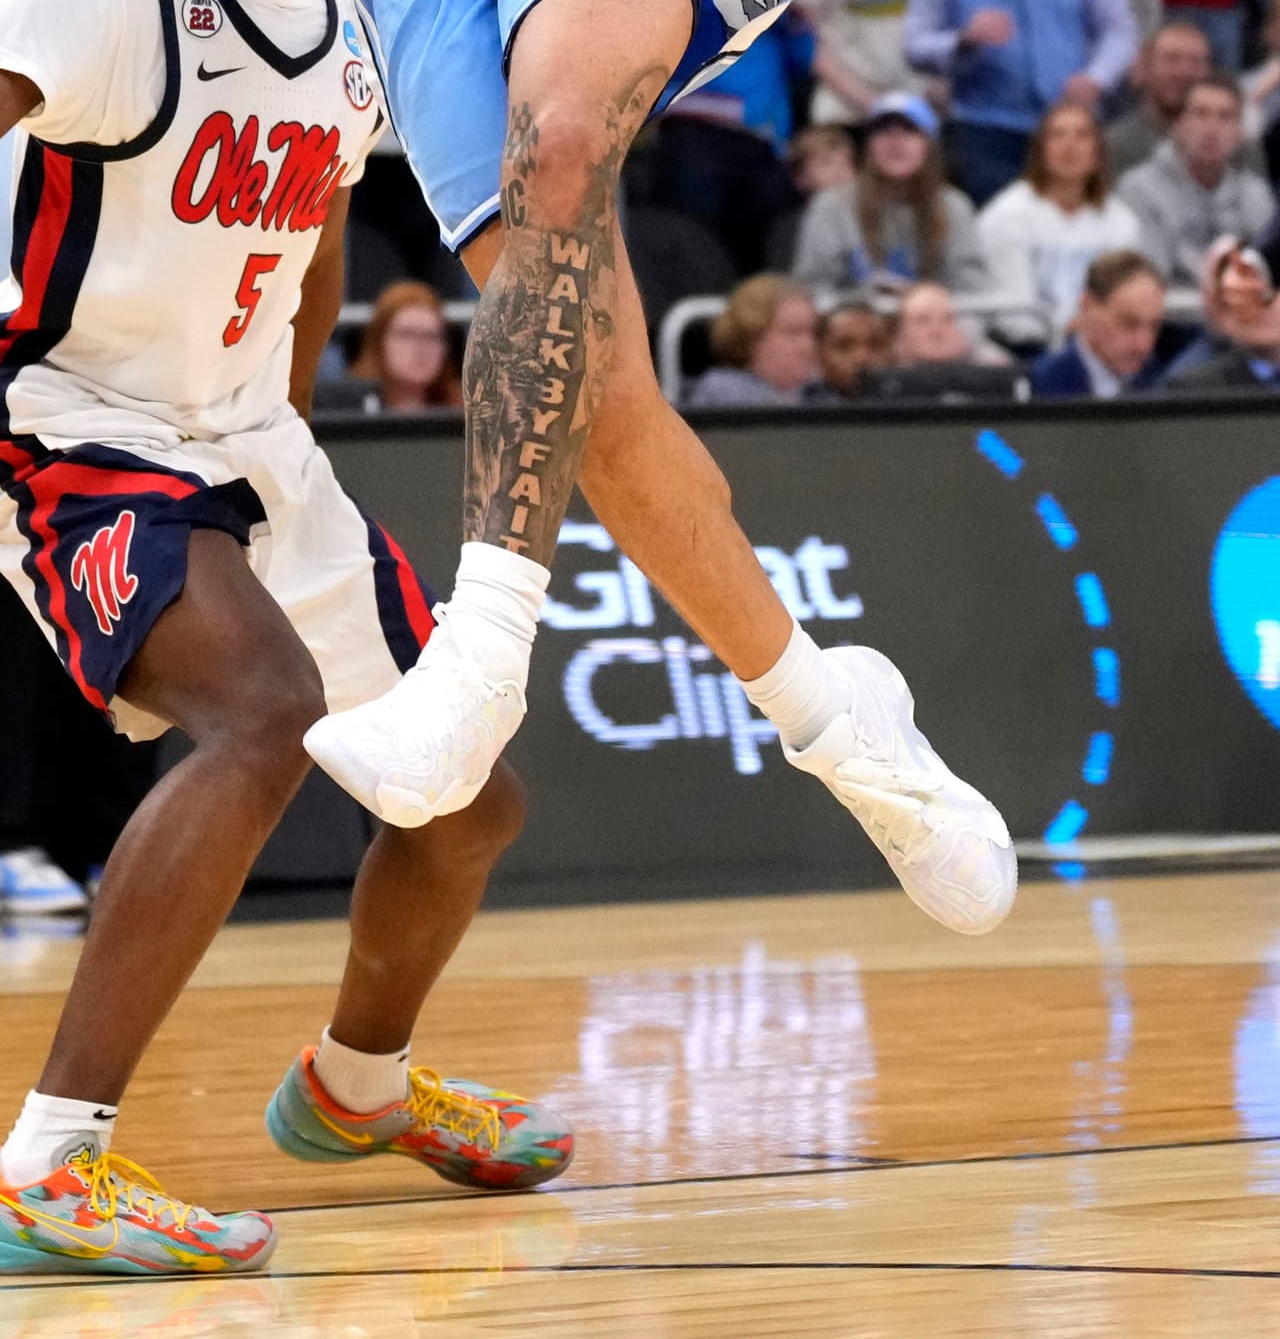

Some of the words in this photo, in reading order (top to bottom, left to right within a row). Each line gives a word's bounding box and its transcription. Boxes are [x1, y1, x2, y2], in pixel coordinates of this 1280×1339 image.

[189, 7, 215, 30] 22
[172, 110, 268, 228] Ole
[222, 253, 283, 348] 5
[538, 233, 591, 372] WALK
[71, 510, 138, 636] M
[563, 636, 782, 775] Clip
